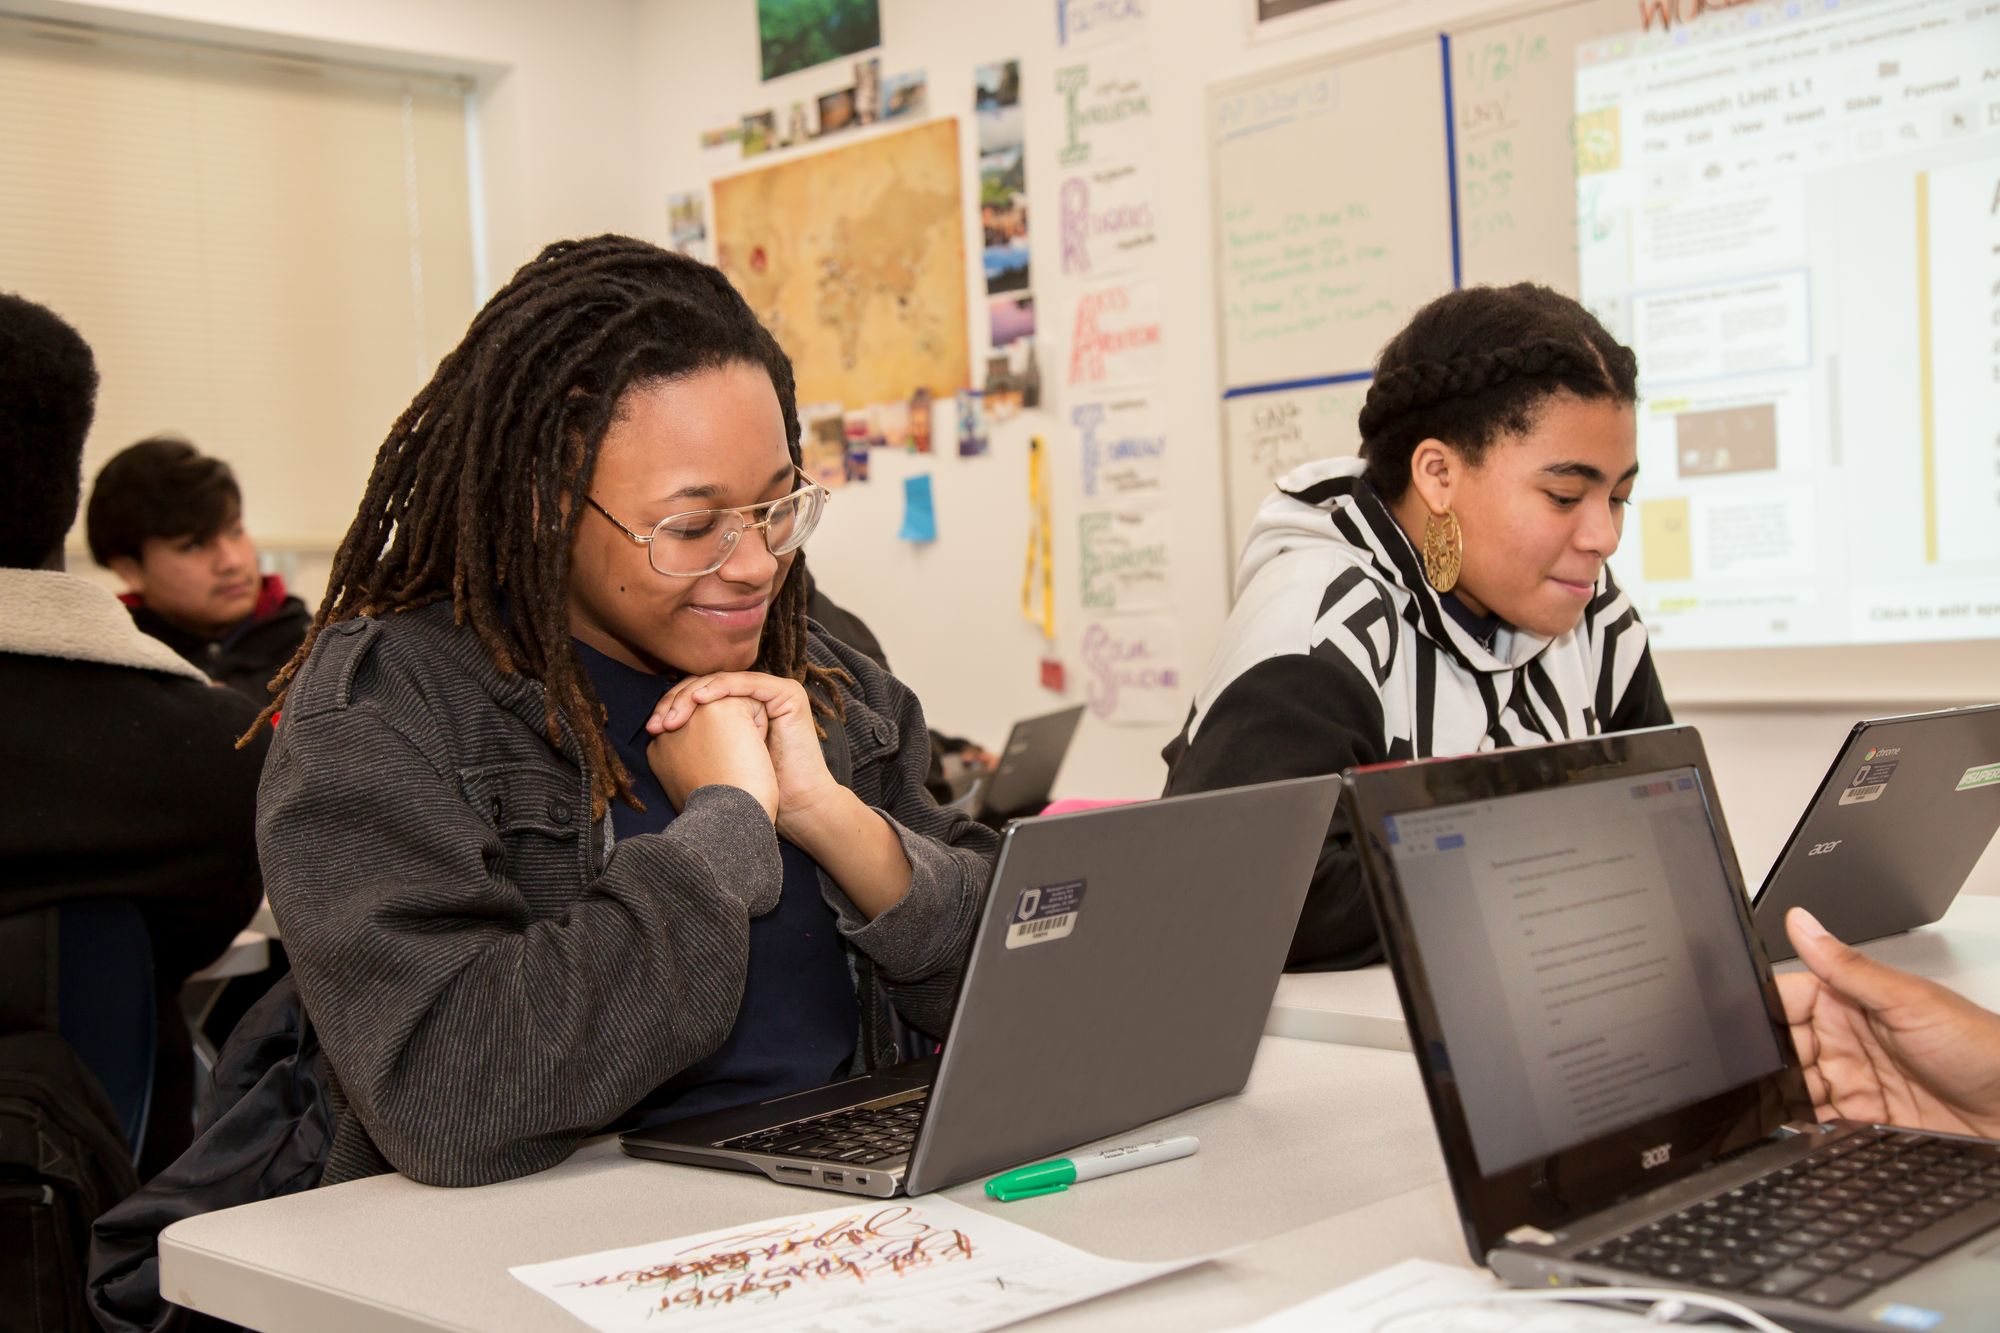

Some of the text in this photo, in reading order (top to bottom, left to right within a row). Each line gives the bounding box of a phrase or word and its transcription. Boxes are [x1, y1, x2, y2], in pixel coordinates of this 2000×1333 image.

[1875, 747, 1901, 758] chrome
[1808, 840, 1843, 856] acer
[1641, 1142, 1672, 1169] acer
